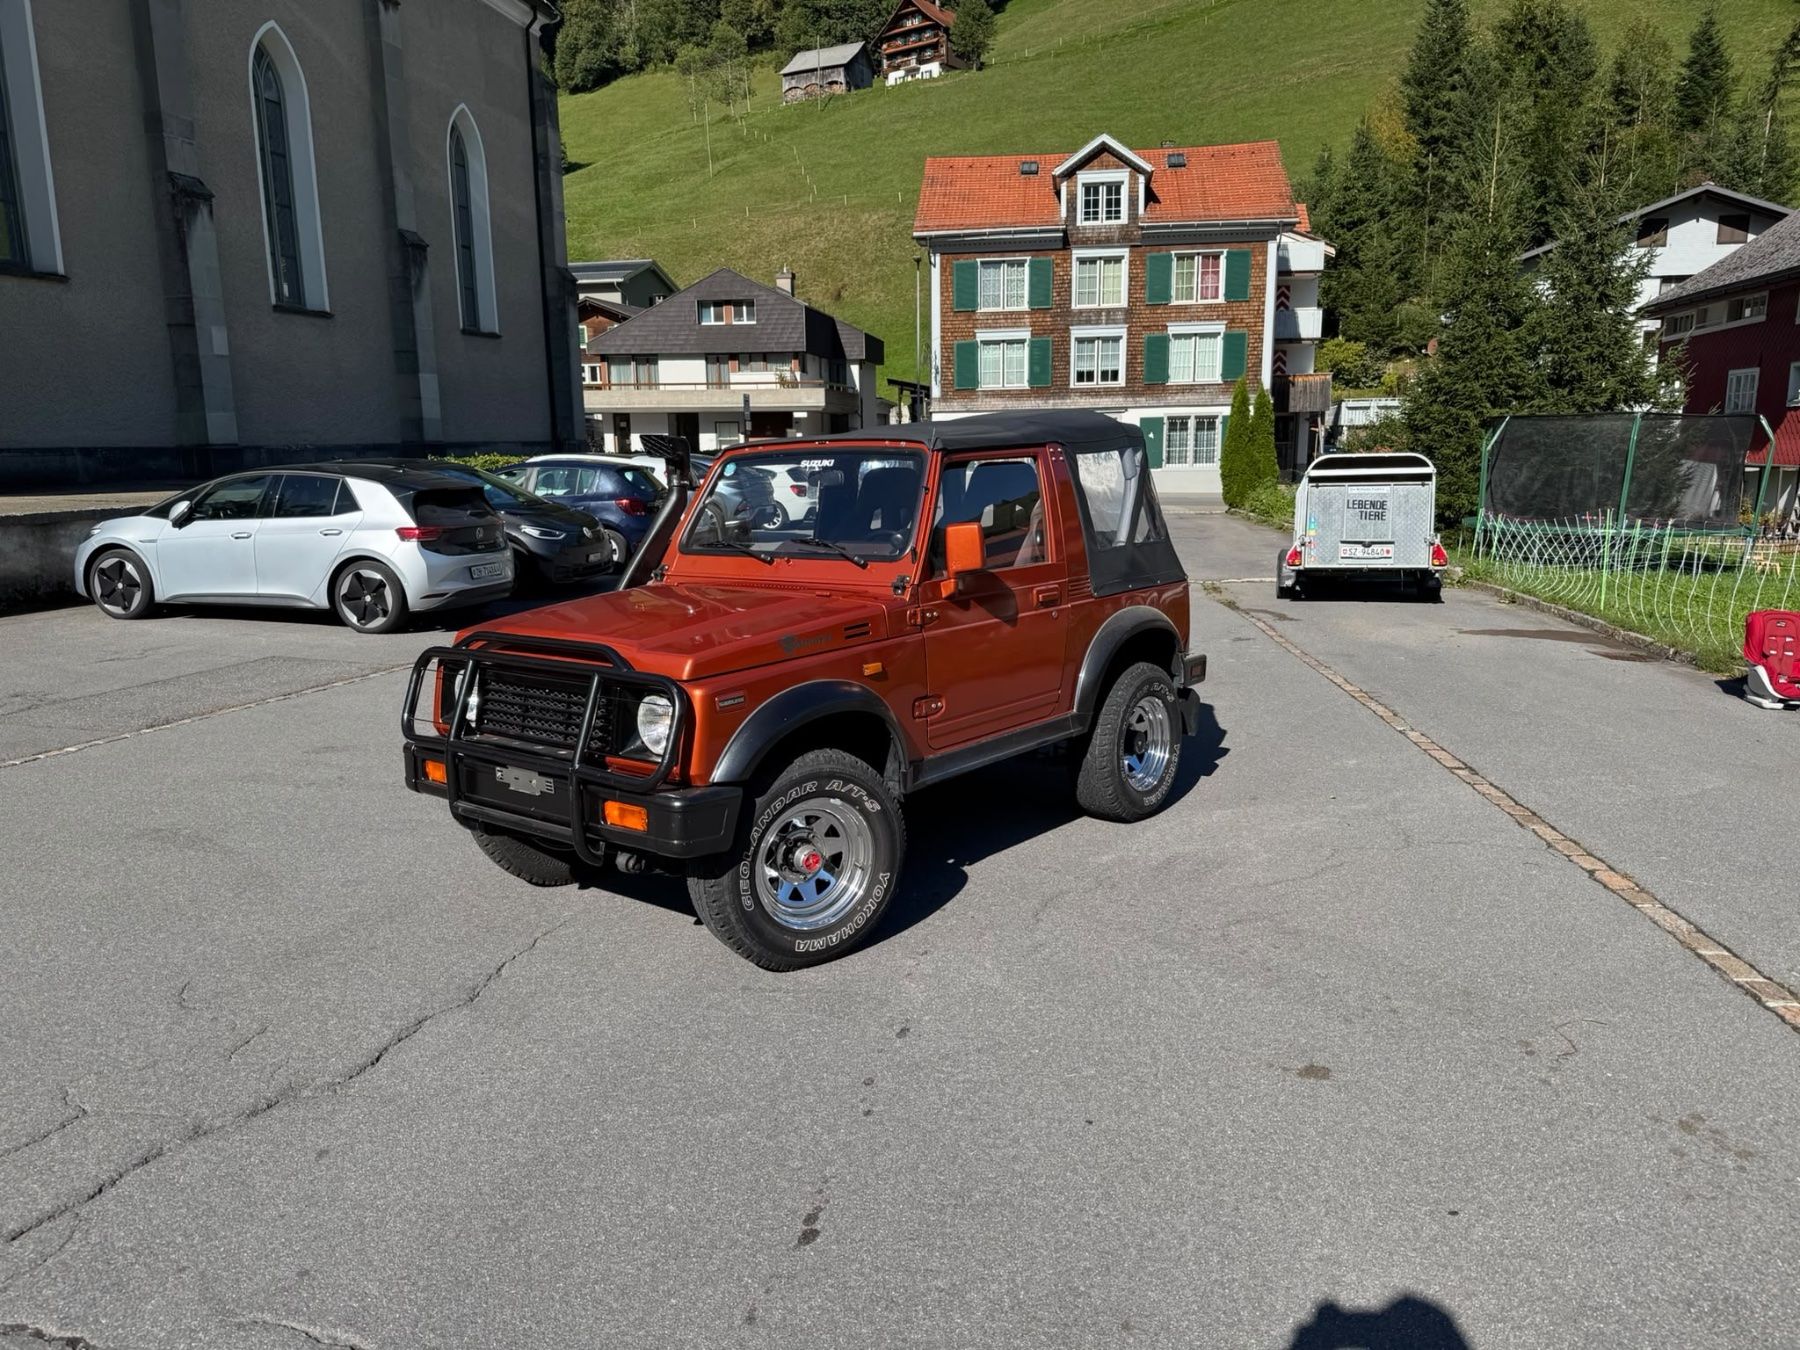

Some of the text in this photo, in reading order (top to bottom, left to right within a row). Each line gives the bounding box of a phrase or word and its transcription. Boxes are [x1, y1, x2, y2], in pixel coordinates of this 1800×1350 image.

[800, 459, 835, 471] SUZUKI
[1346, 499, 1388, 510] LEBENDE
[1359, 510, 1387, 521] TIERE
[739, 781, 818, 911] GEOLANDAR
[795, 872, 890, 952] YOKOHAMA
